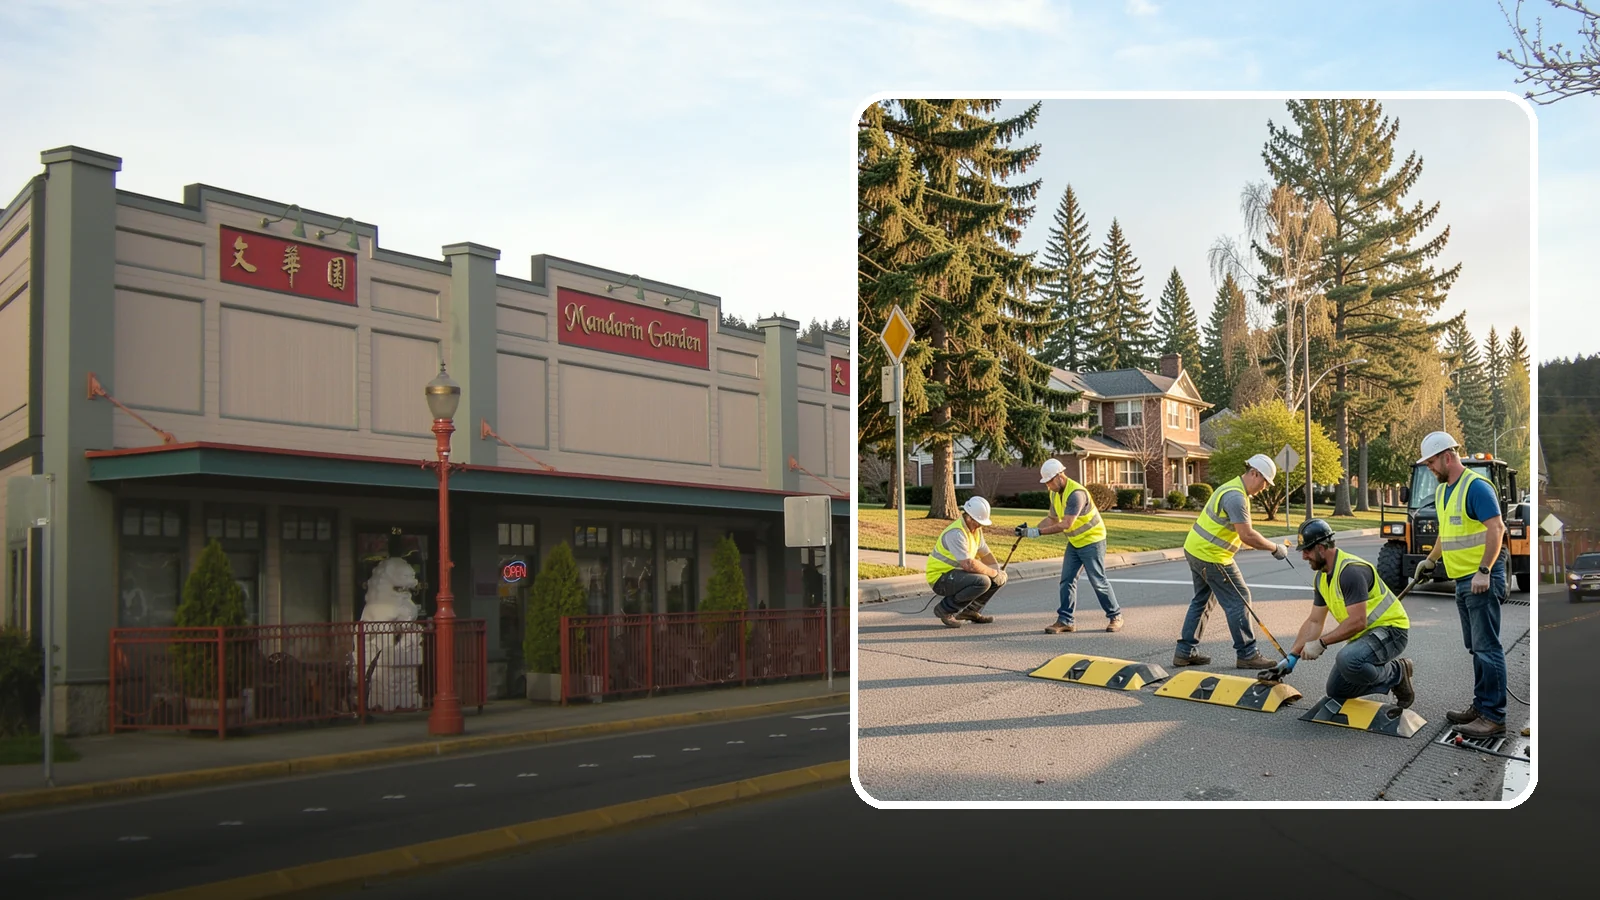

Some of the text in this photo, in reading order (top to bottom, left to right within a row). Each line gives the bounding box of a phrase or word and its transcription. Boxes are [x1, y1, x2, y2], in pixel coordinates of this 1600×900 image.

[230, 235, 346, 291] 文華園
[565, 302, 701, 352] Mandarin Garden
[503, 565, 527, 578] OPEN
